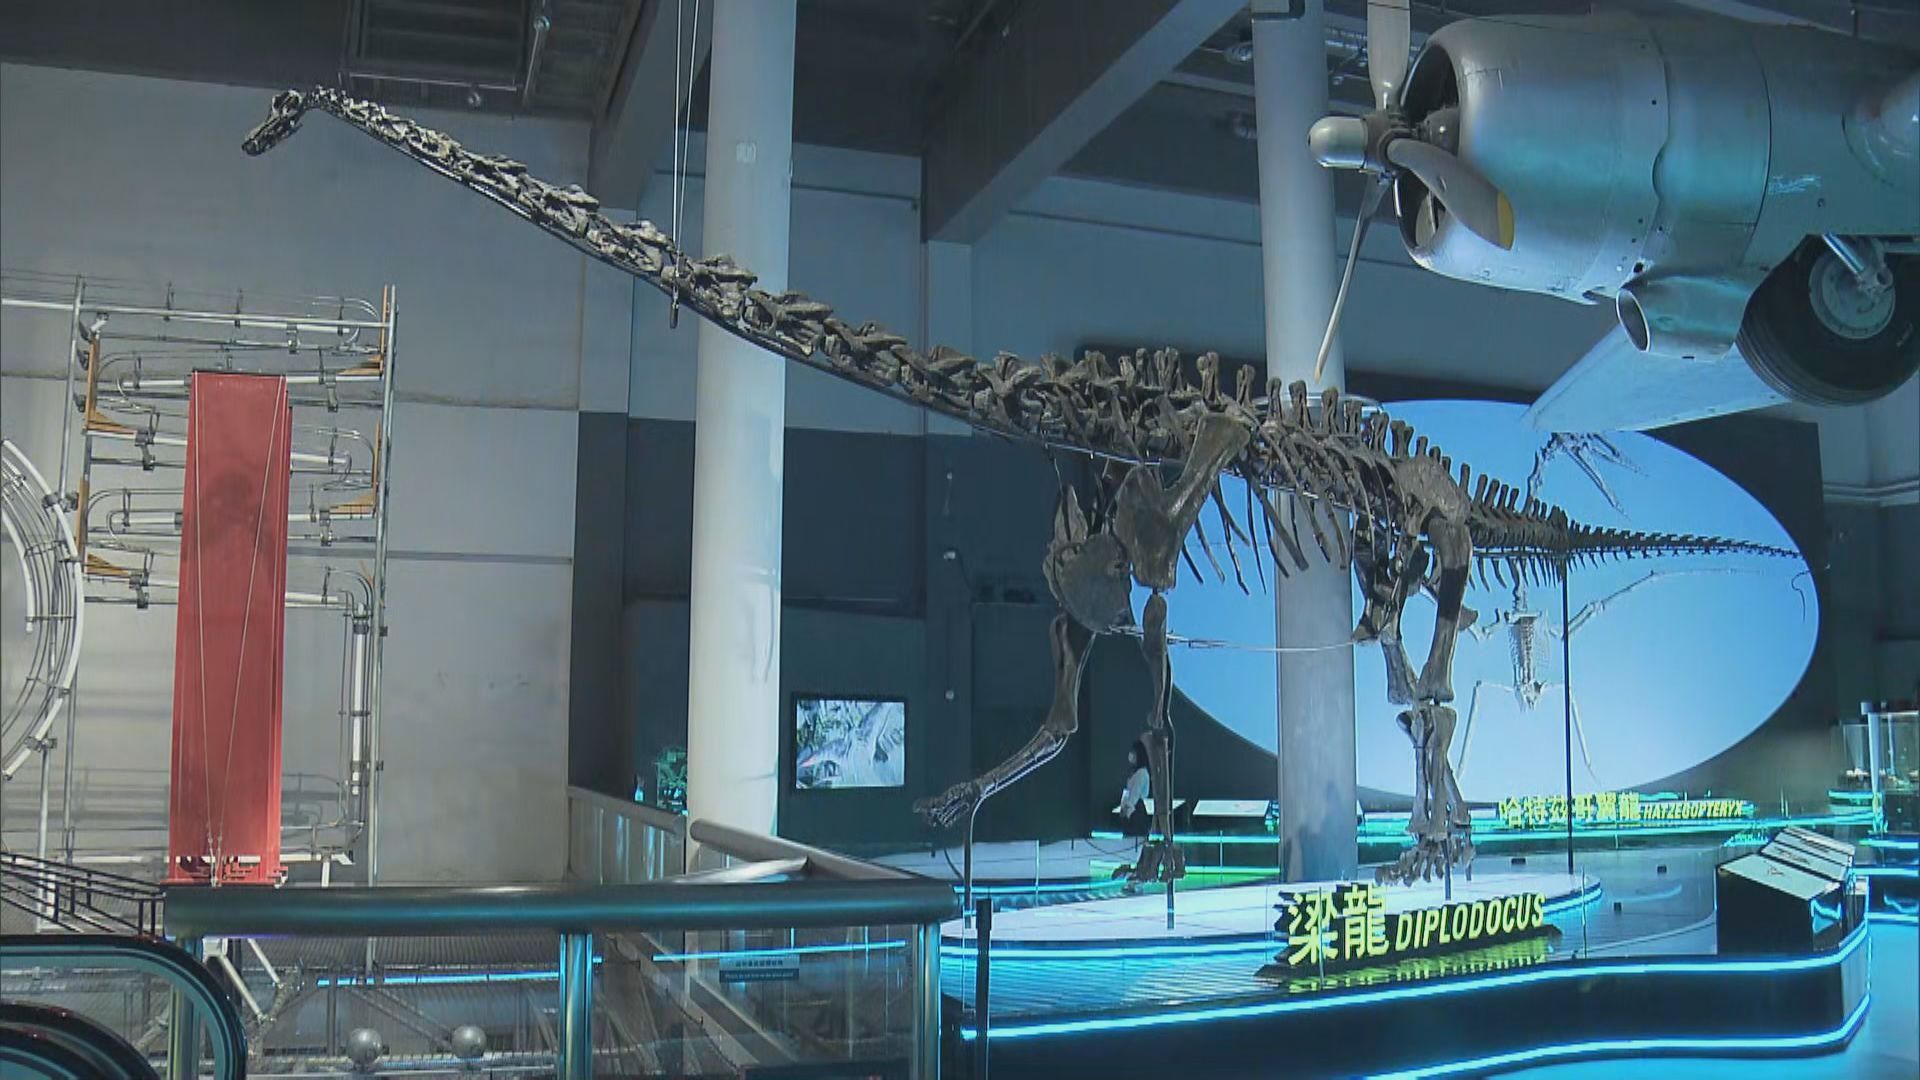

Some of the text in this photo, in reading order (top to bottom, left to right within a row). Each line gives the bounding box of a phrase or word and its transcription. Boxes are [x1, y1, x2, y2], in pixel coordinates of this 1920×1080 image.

[1643, 801, 1743, 820] HATZEGOPTERYX
[1288, 883, 1389, 965] 梁龍
[1395, 893, 1545, 951] DIPLODOCUS
